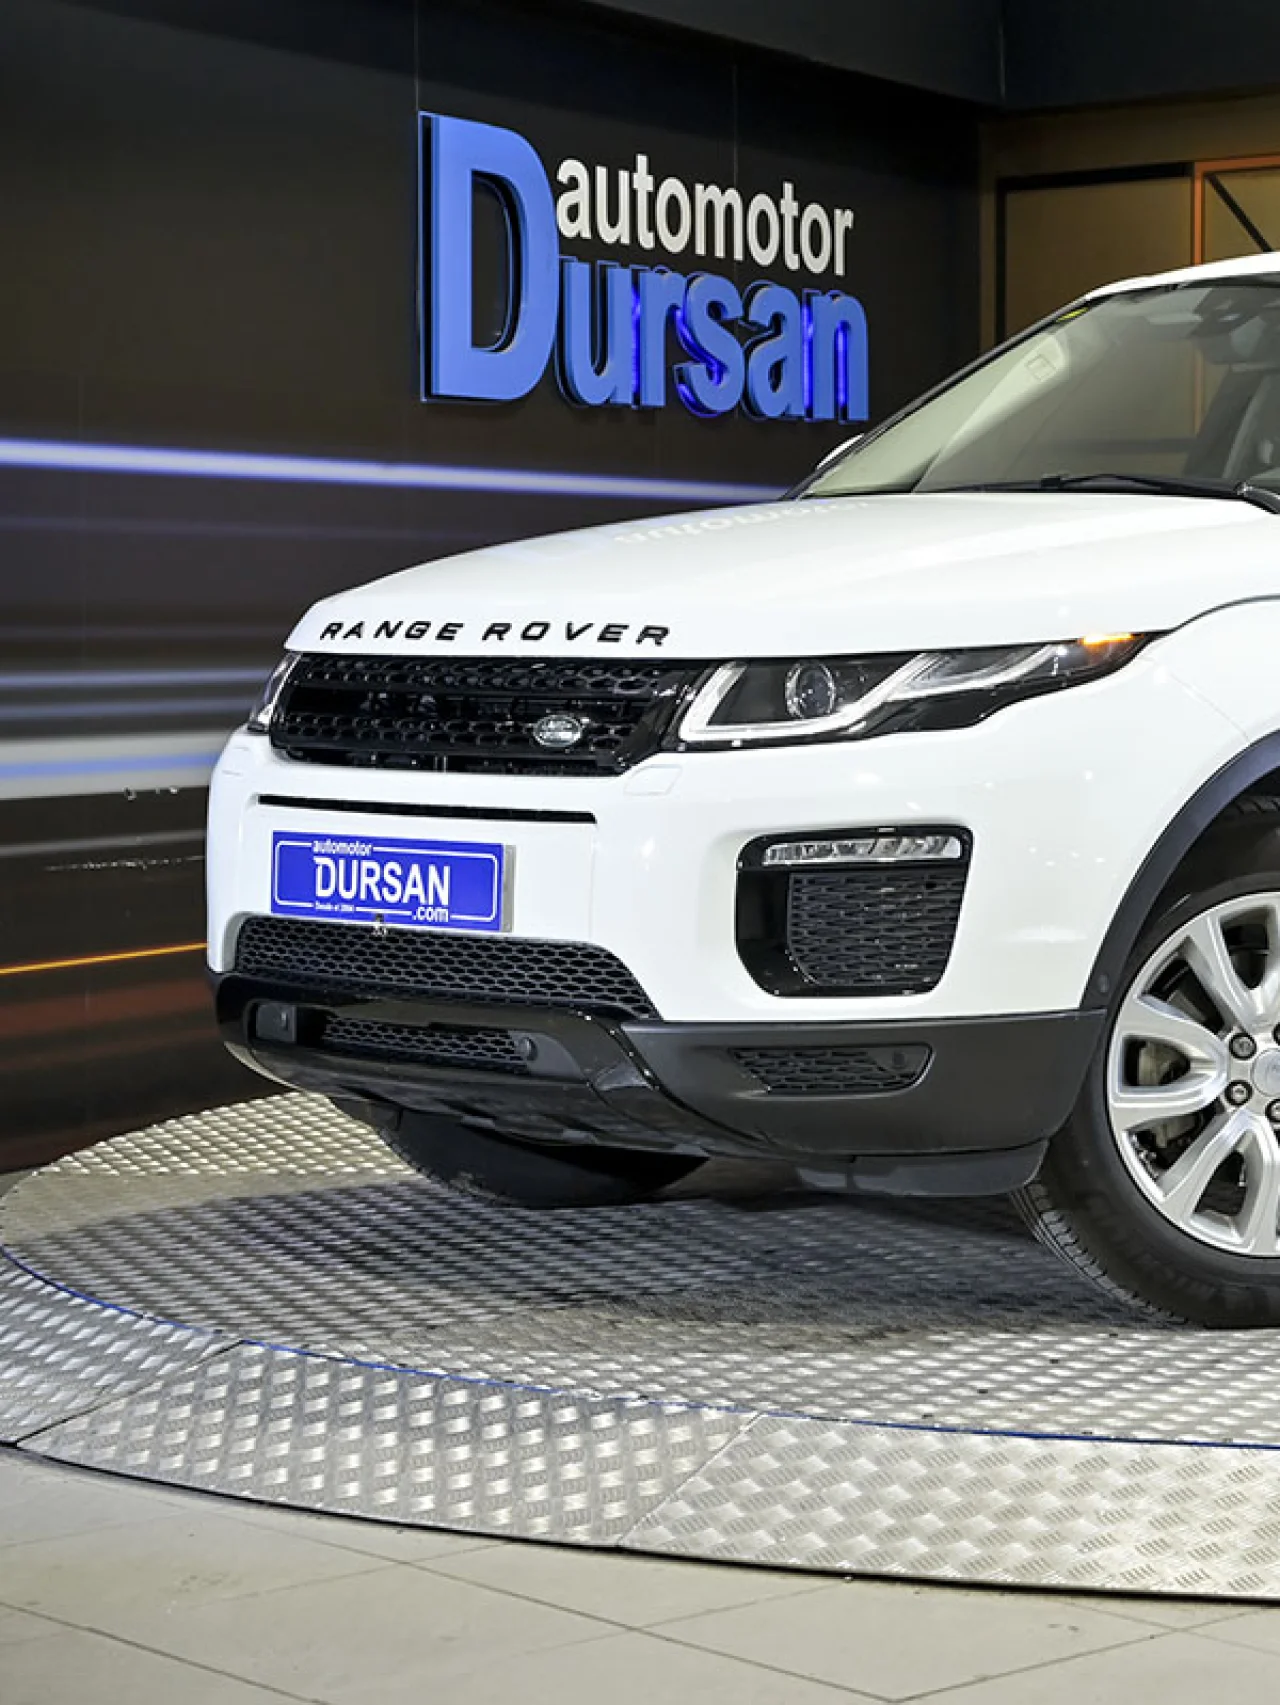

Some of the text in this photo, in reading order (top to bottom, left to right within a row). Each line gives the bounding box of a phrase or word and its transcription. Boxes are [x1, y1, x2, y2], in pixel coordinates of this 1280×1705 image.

[555, 154, 853, 276] automotor
[419, 111, 868, 424] Dursan
[320, 621, 671, 646] RANGE ROVER
[313, 840, 372, 856] automotor
[313, 857, 450, 906] DURSAN
[413, 906, 449, 922] .com
